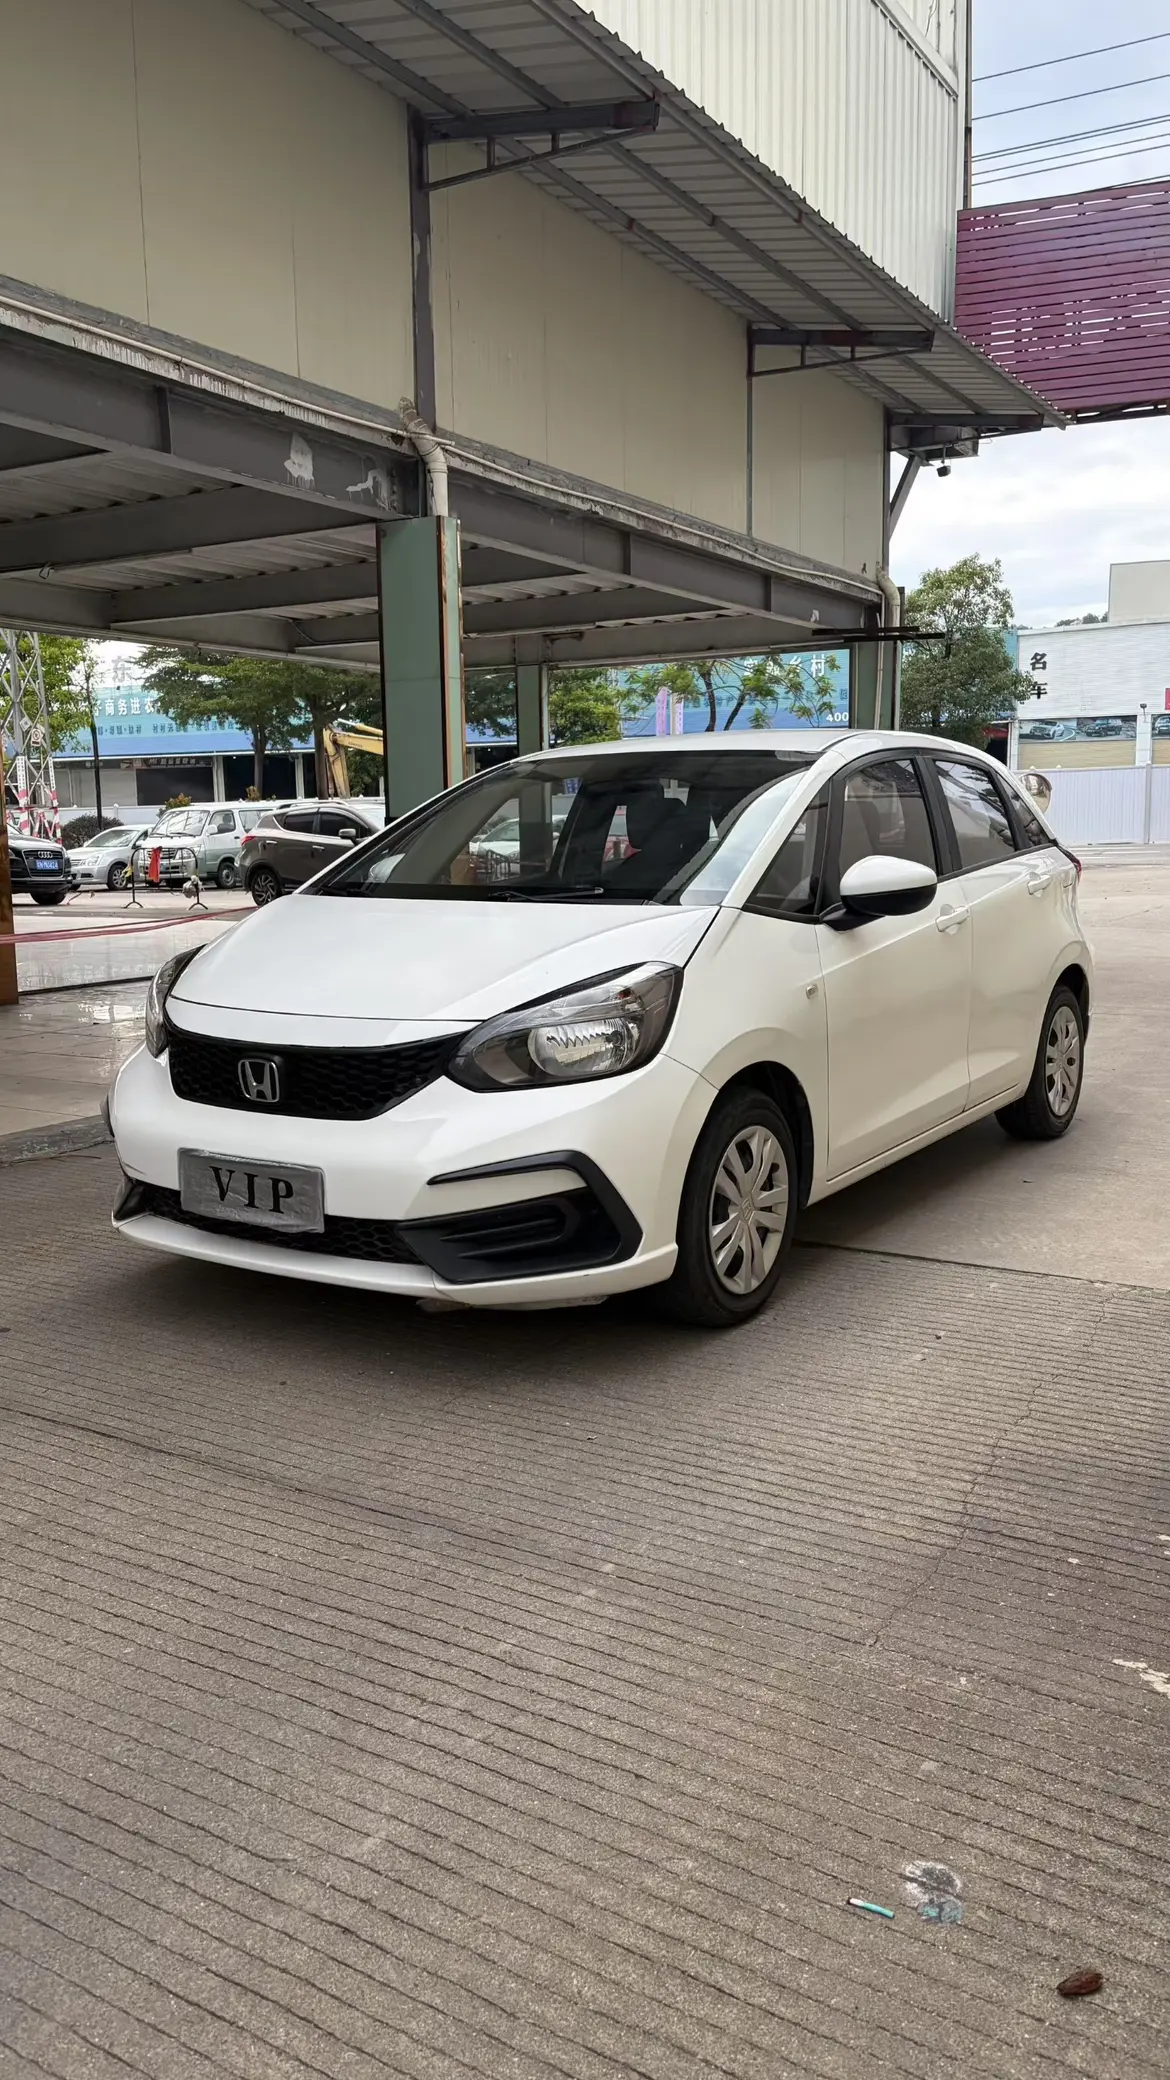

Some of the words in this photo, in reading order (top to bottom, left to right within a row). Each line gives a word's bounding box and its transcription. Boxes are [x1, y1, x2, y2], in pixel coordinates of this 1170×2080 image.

[1030, 652, 1048, 699] 名车
[826, 712, 849, 722] 400
[209, 1166, 294, 1214] VIP
